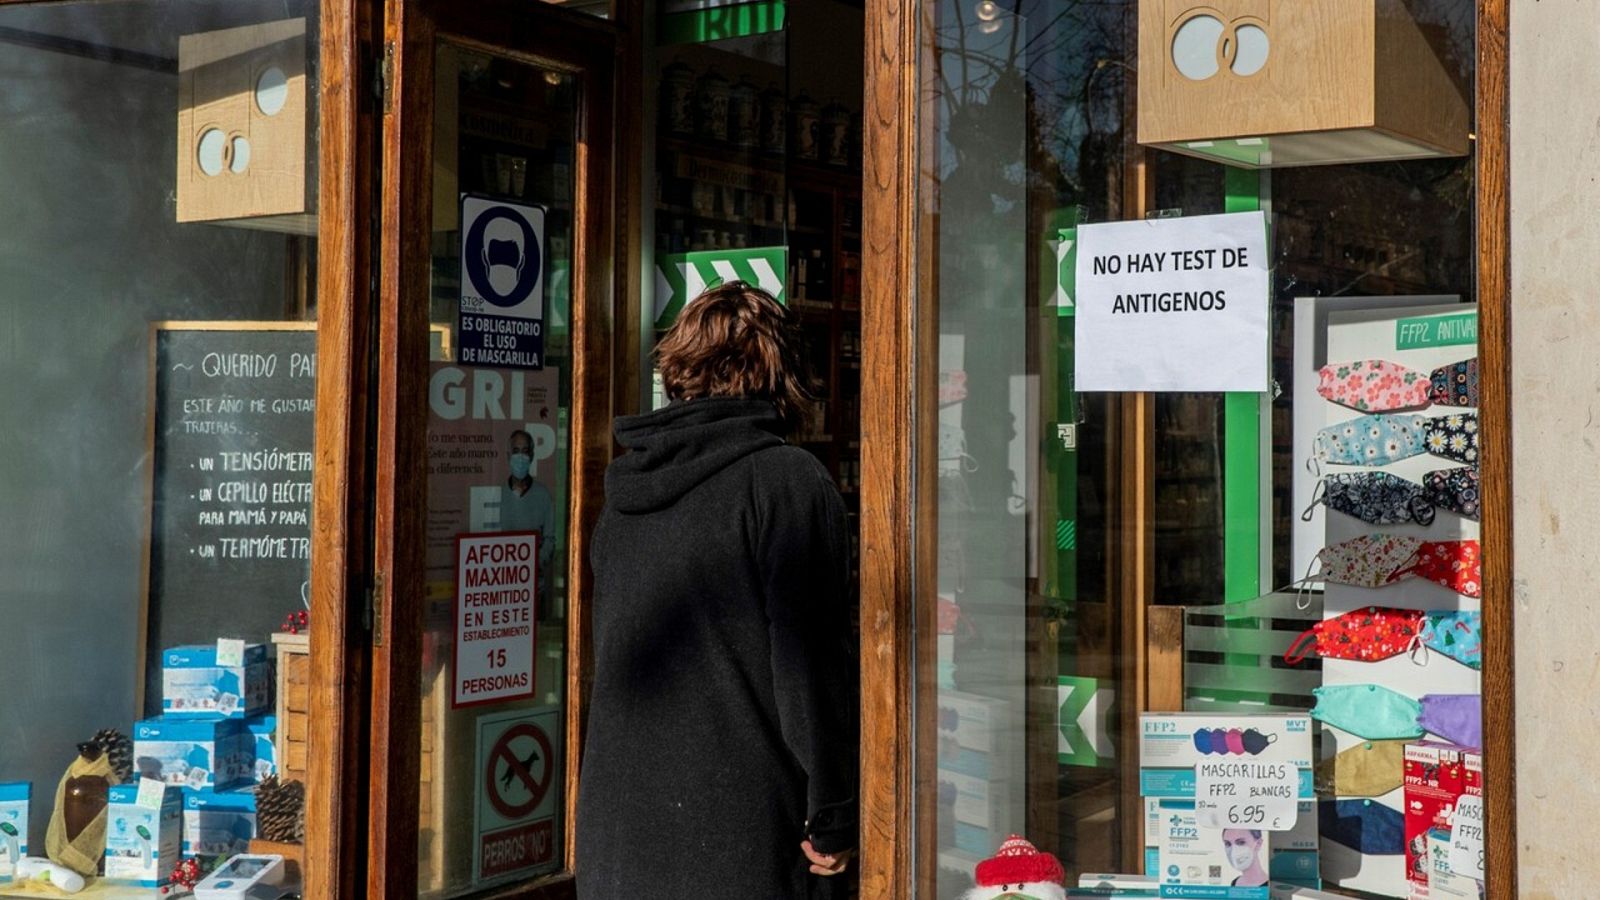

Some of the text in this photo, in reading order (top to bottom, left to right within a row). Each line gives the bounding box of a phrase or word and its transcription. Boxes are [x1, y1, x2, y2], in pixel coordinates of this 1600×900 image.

[1093, 247, 1249, 275] NO HAY TEST DE
[1112, 290, 1226, 314] ANTIGENOS
[462, 316, 541, 337] ES OBLIGATORIO
[1399, 317, 1476, 343] FFP2 ANTIVA
[483, 334, 517, 350] EL USO
[462, 347, 539, 367] DE MASCARILLA
[428, 366, 525, 420] GRI
[183, 399, 214, 414] ESTE
[217, 394, 244, 414] AÑO
[250, 400, 267, 414] ME
[199, 457, 215, 471] UN
[199, 488, 213, 502] UN
[217, 481, 268, 503] CEPILLO
[199, 507, 308, 526] PARA MAMÁ Y PAPÁ
[198, 545, 215, 558] UN
[465, 542, 531, 565] AFORO
[465, 565, 531, 588] MAXIMO
[464, 588, 531, 608] PERMITIDO
[464, 607, 530, 627] EN ESTE
[463, 624, 530, 642] ESTABLECIMIENTO
[486, 648, 507, 669] 15
[462, 672, 529, 695] PERSONAS
[1144, 722, 1177, 733] FFP2
[1286, 720, 1308, 728] MVT
[1201, 763, 1287, 780] MASCARILLAS
[1405, 775, 1423, 786] FFP2
[1209, 784, 1292, 799] FFP2 BLANCAS
[1228, 804, 1266, 825] 6.95
[1272, 816, 1281, 829] €
[1170, 827, 1198, 838] FFP2
[1459, 824, 1482, 841] FFP2
[483, 834, 526, 869] PERROS
